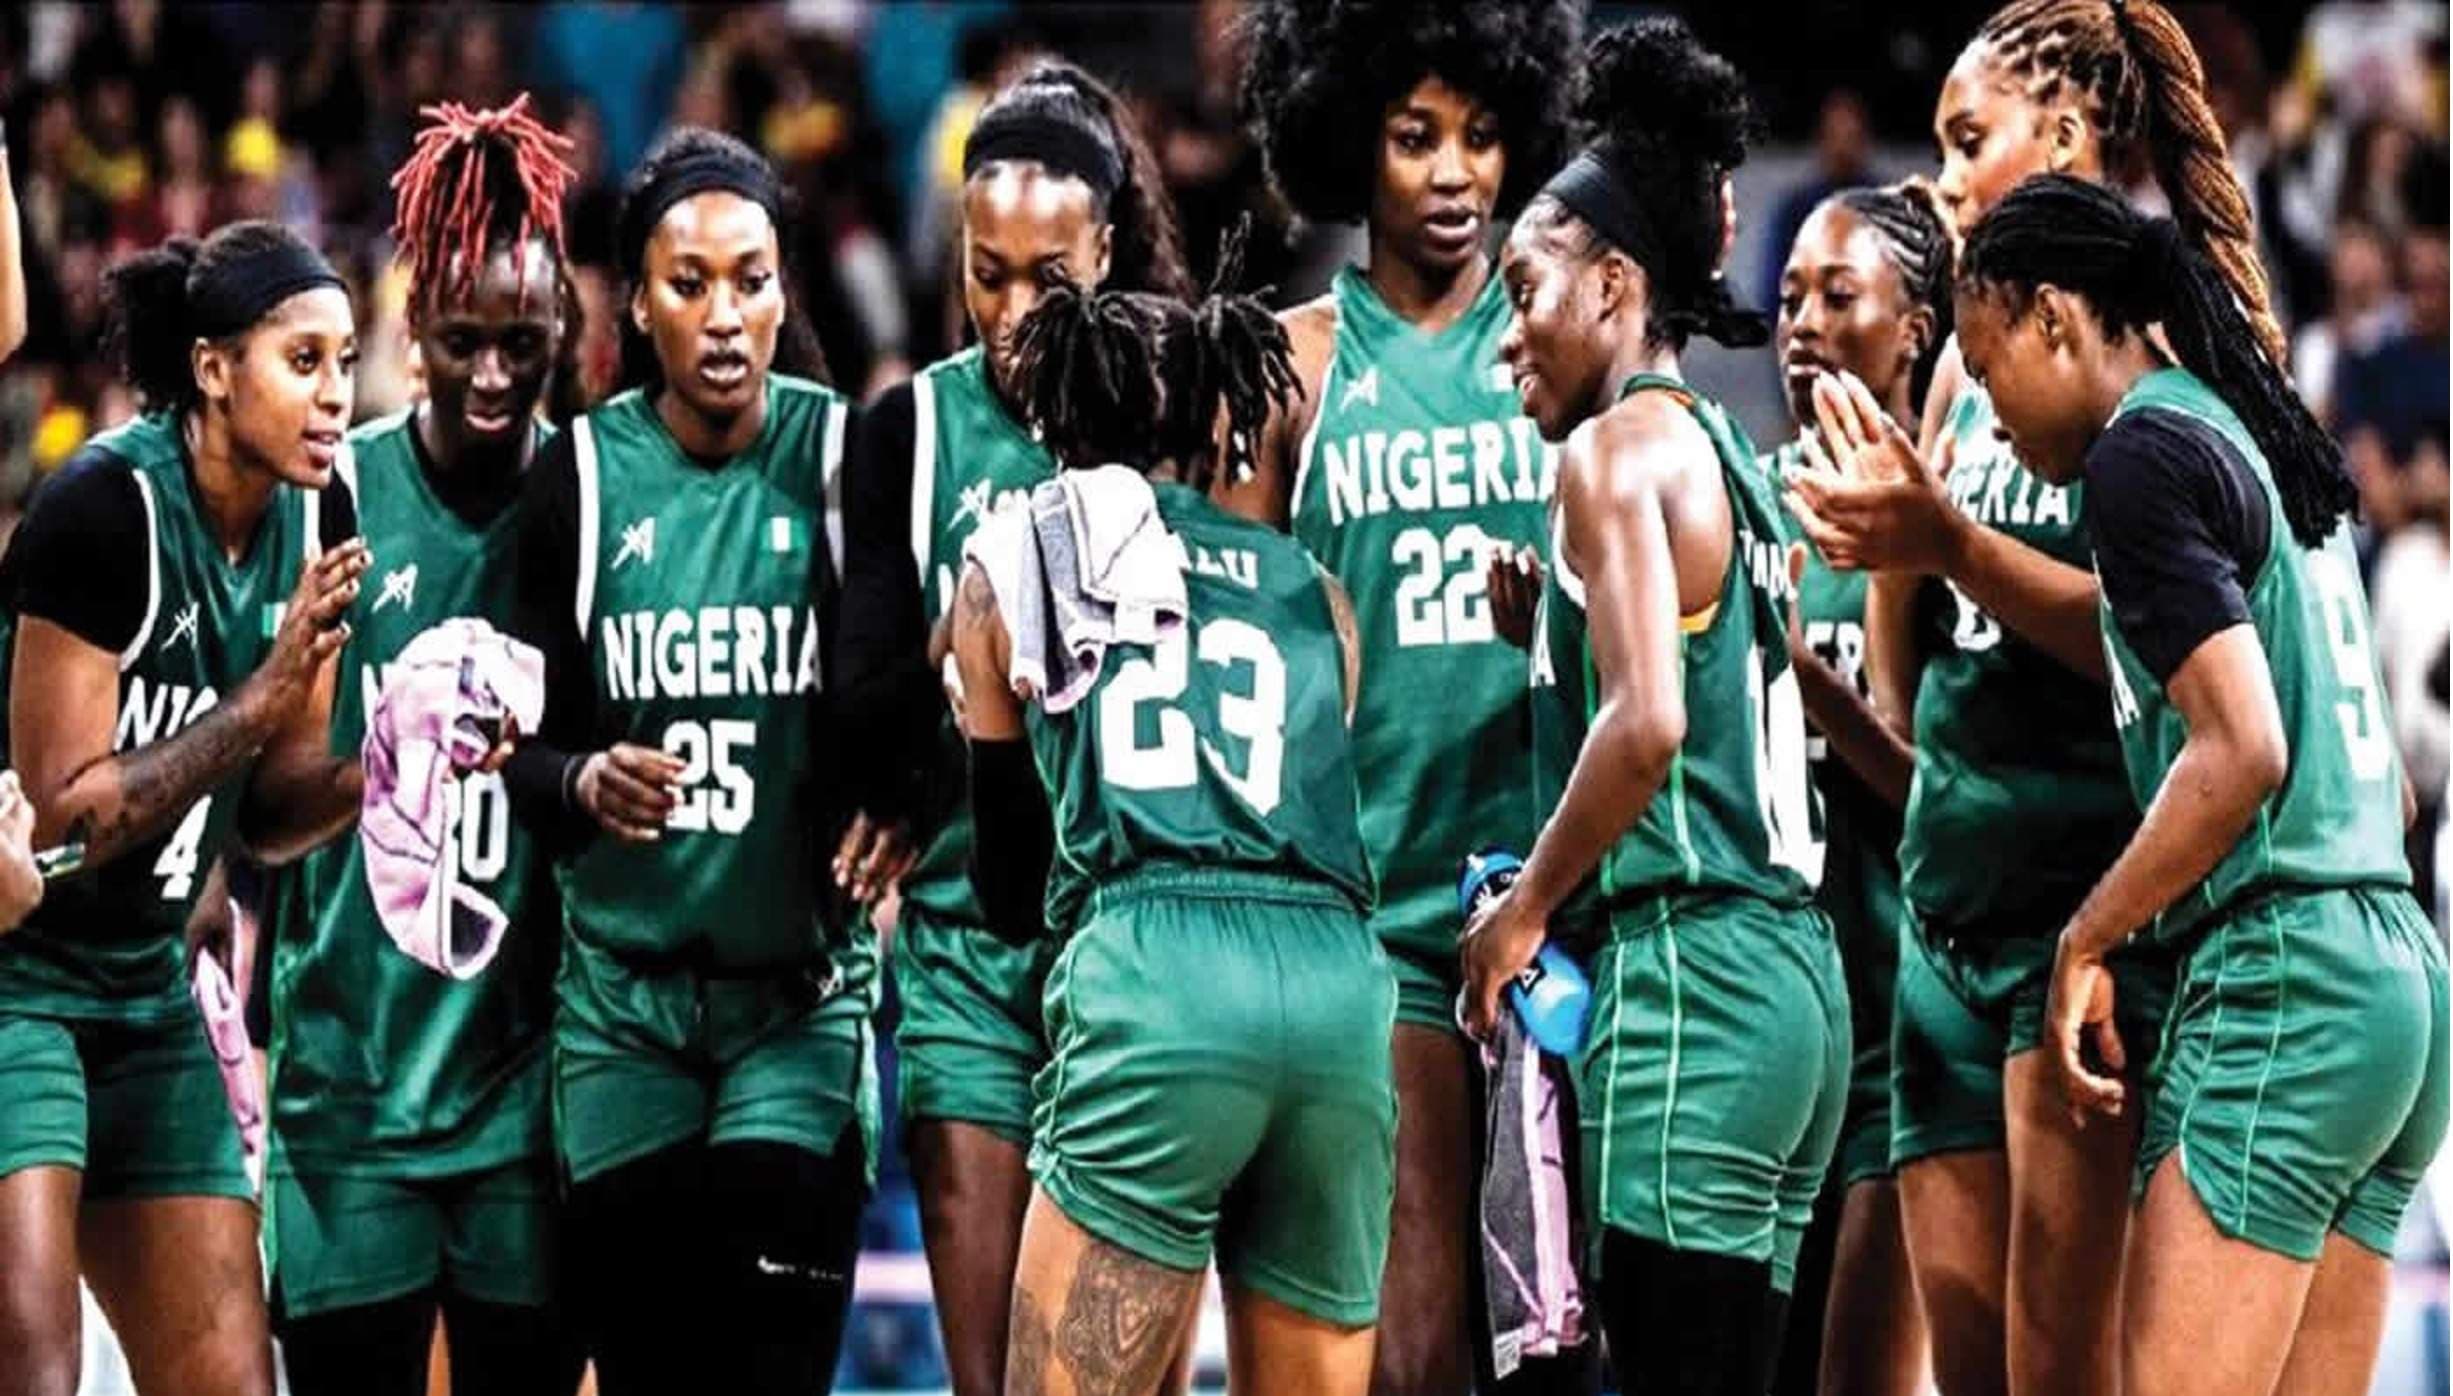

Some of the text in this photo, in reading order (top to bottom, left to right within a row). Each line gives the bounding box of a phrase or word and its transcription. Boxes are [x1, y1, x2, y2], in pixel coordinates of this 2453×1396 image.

[1181, 543, 1260, 590] LU
[1391, 523, 1500, 647] 22
[602, 605, 823, 699] NIGERIA
[1098, 617, 1287, 818] 23
[661, 718, 757, 835] 25
[152, 794, 213, 899] 4
